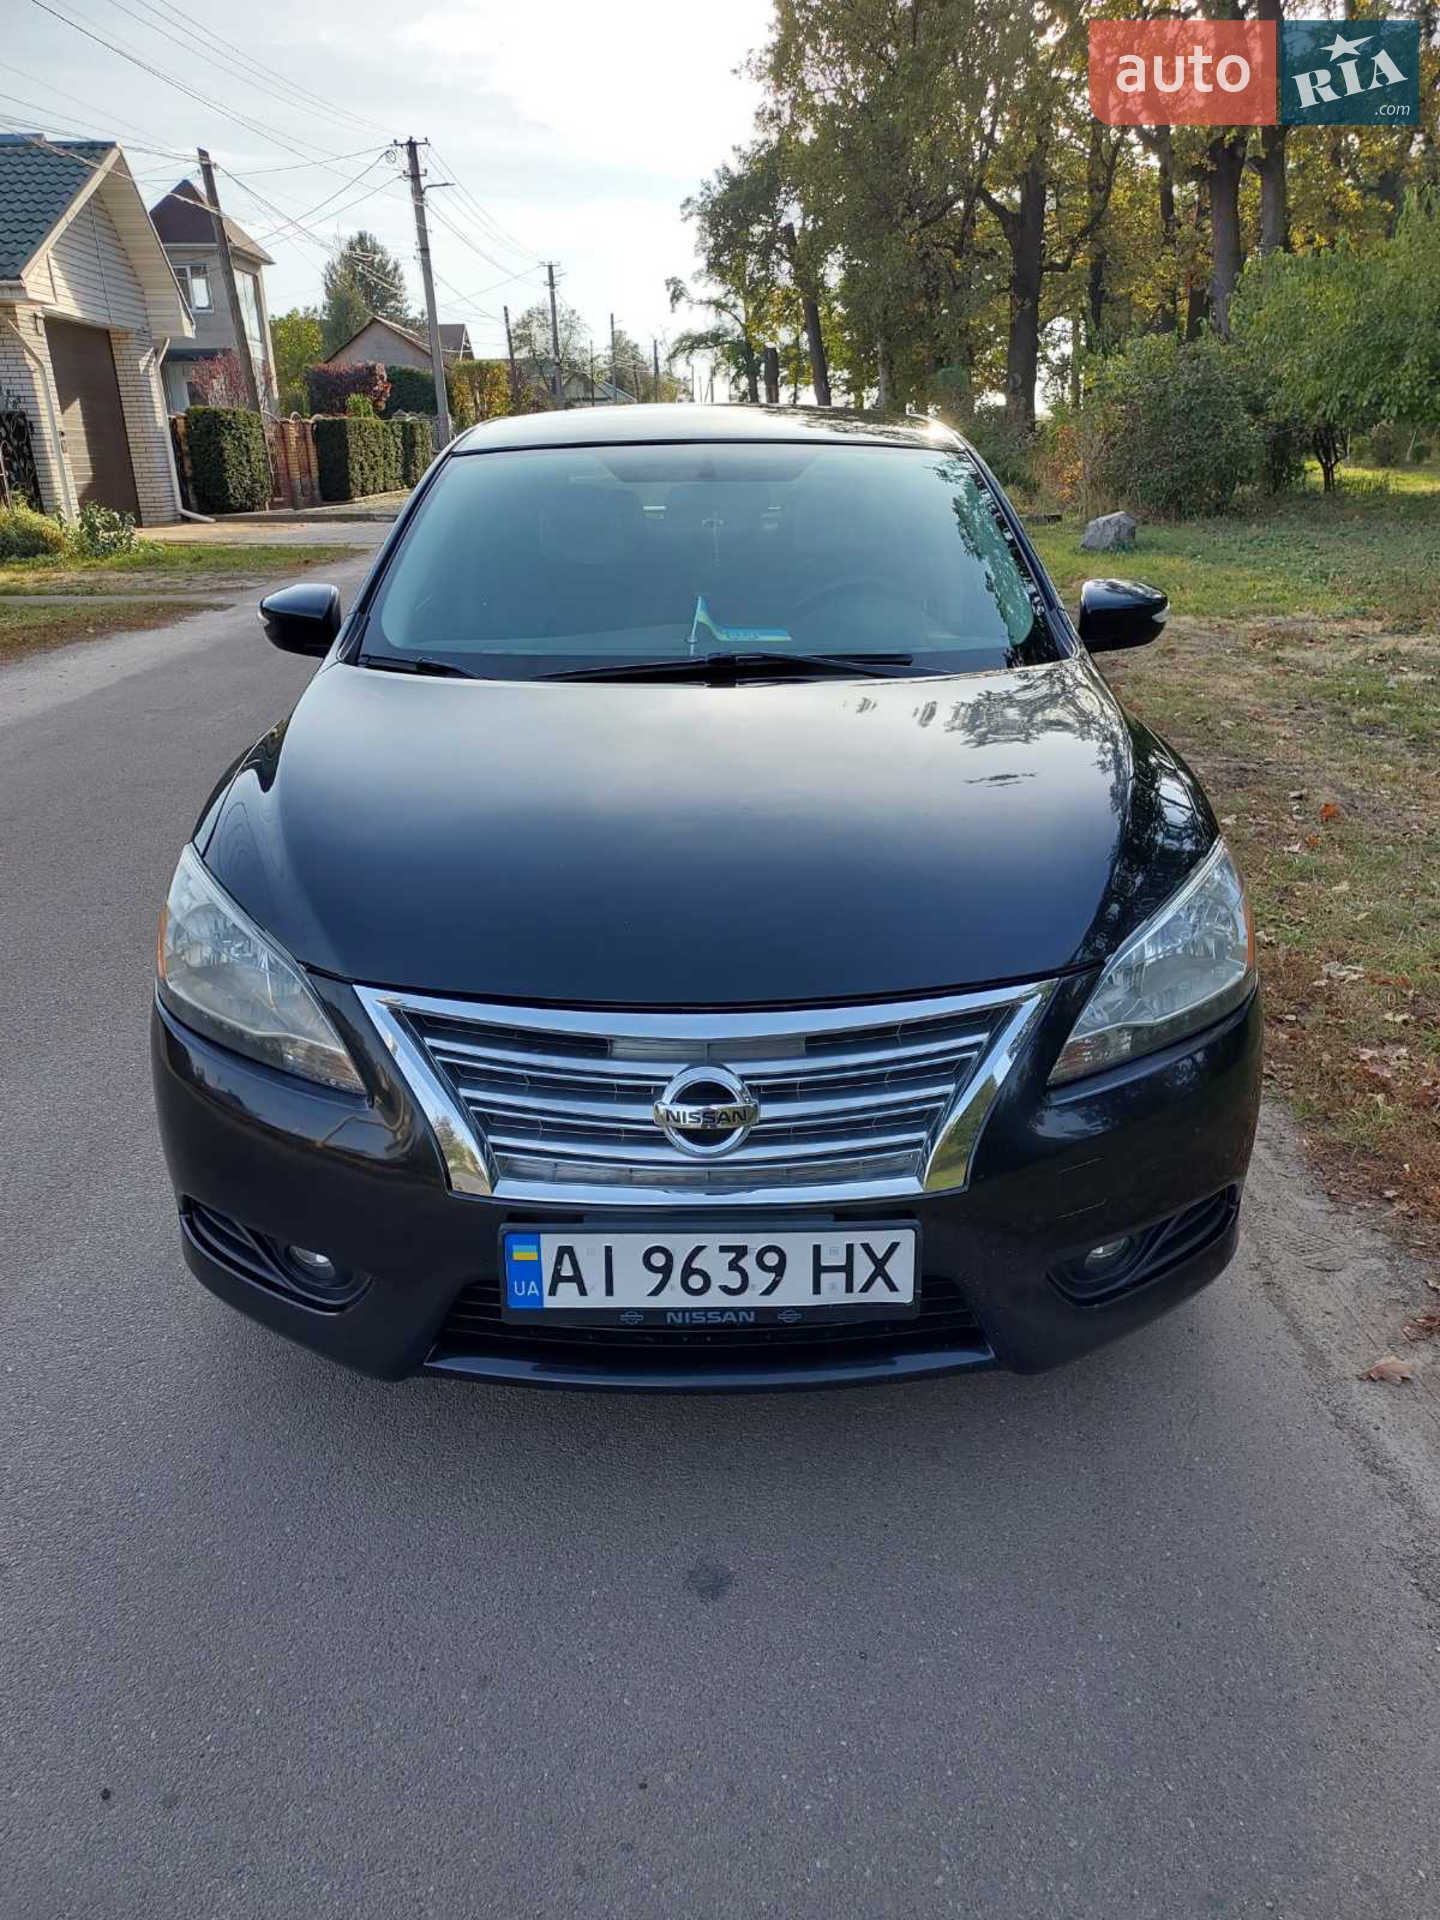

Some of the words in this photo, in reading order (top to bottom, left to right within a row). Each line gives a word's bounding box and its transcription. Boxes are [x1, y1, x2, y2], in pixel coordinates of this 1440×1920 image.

[665, 1109, 749, 1124] NISSAN
[547, 1244, 615, 1297] AI
[642, 1244, 788, 1297] 9639
[812, 1241, 901, 1296] HX
[514, 1281, 540, 1297] UA
[666, 1310, 756, 1324] NISSAN
